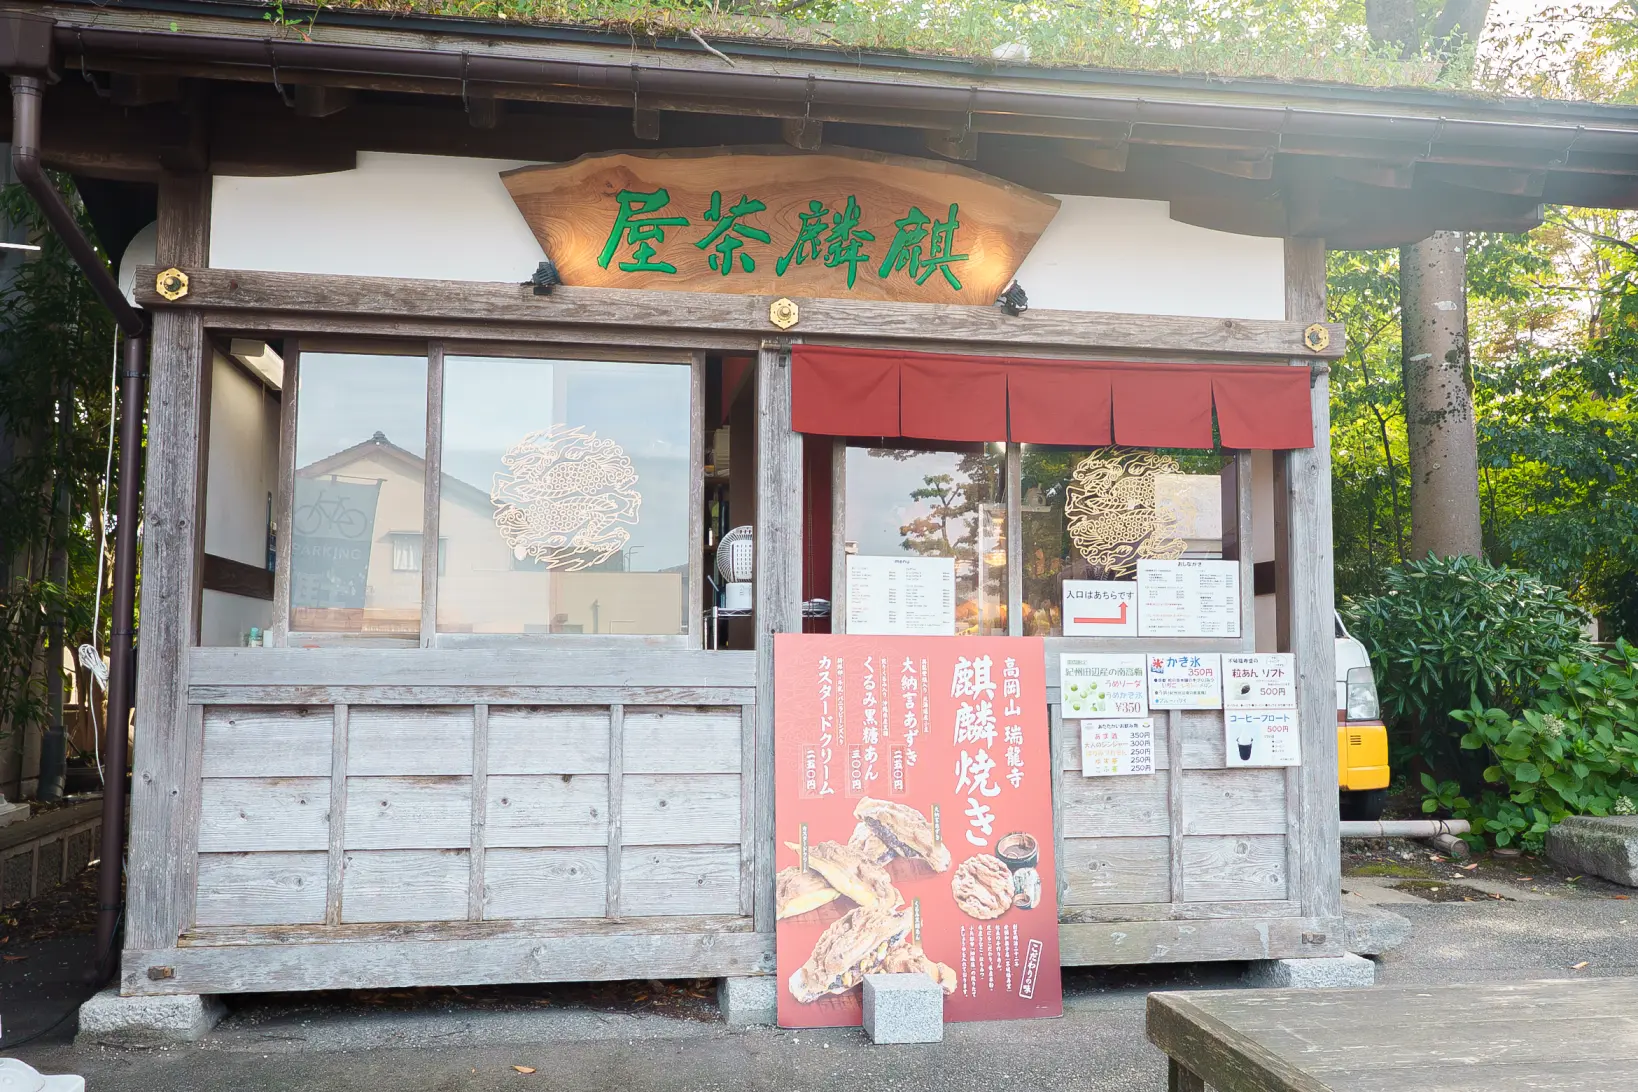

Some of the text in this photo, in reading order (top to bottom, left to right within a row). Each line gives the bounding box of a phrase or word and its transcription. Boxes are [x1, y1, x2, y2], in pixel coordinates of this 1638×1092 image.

[1066, 589, 1135, 601] 入口はあちらです
[1166, 656, 1201, 668] かき氷
[1065, 667, 1143, 677] 紀州田辺産の南高梅
[1188, 668, 1213, 677] 350円
[1231, 668, 1259, 678] 粒あん
[1104, 680, 1142, 688] うめソーダ
[1105, 691, 1143, 699] うめかき氷
[1260, 687, 1286, 696] 500円
[900, 658, 919, 767] 大納言あずき
[1115, 702, 1141, 714] ¥350
[862, 655, 879, 781] くるみ黒糖あん
[1230, 714, 1290, 723] コーヒーフロート
[817, 655, 836, 796] カスタードクリーム
[1003, 658, 1025, 789] 高岡山 瑞龍寺
[950, 655, 1001, 847] 麒麟焼き
[1130, 748, 1151, 756] 250円
[1130, 756, 1151, 764] 250円
[1130, 764, 1152, 772] 250円
[1023, 944, 1039, 994] こだわりの味
